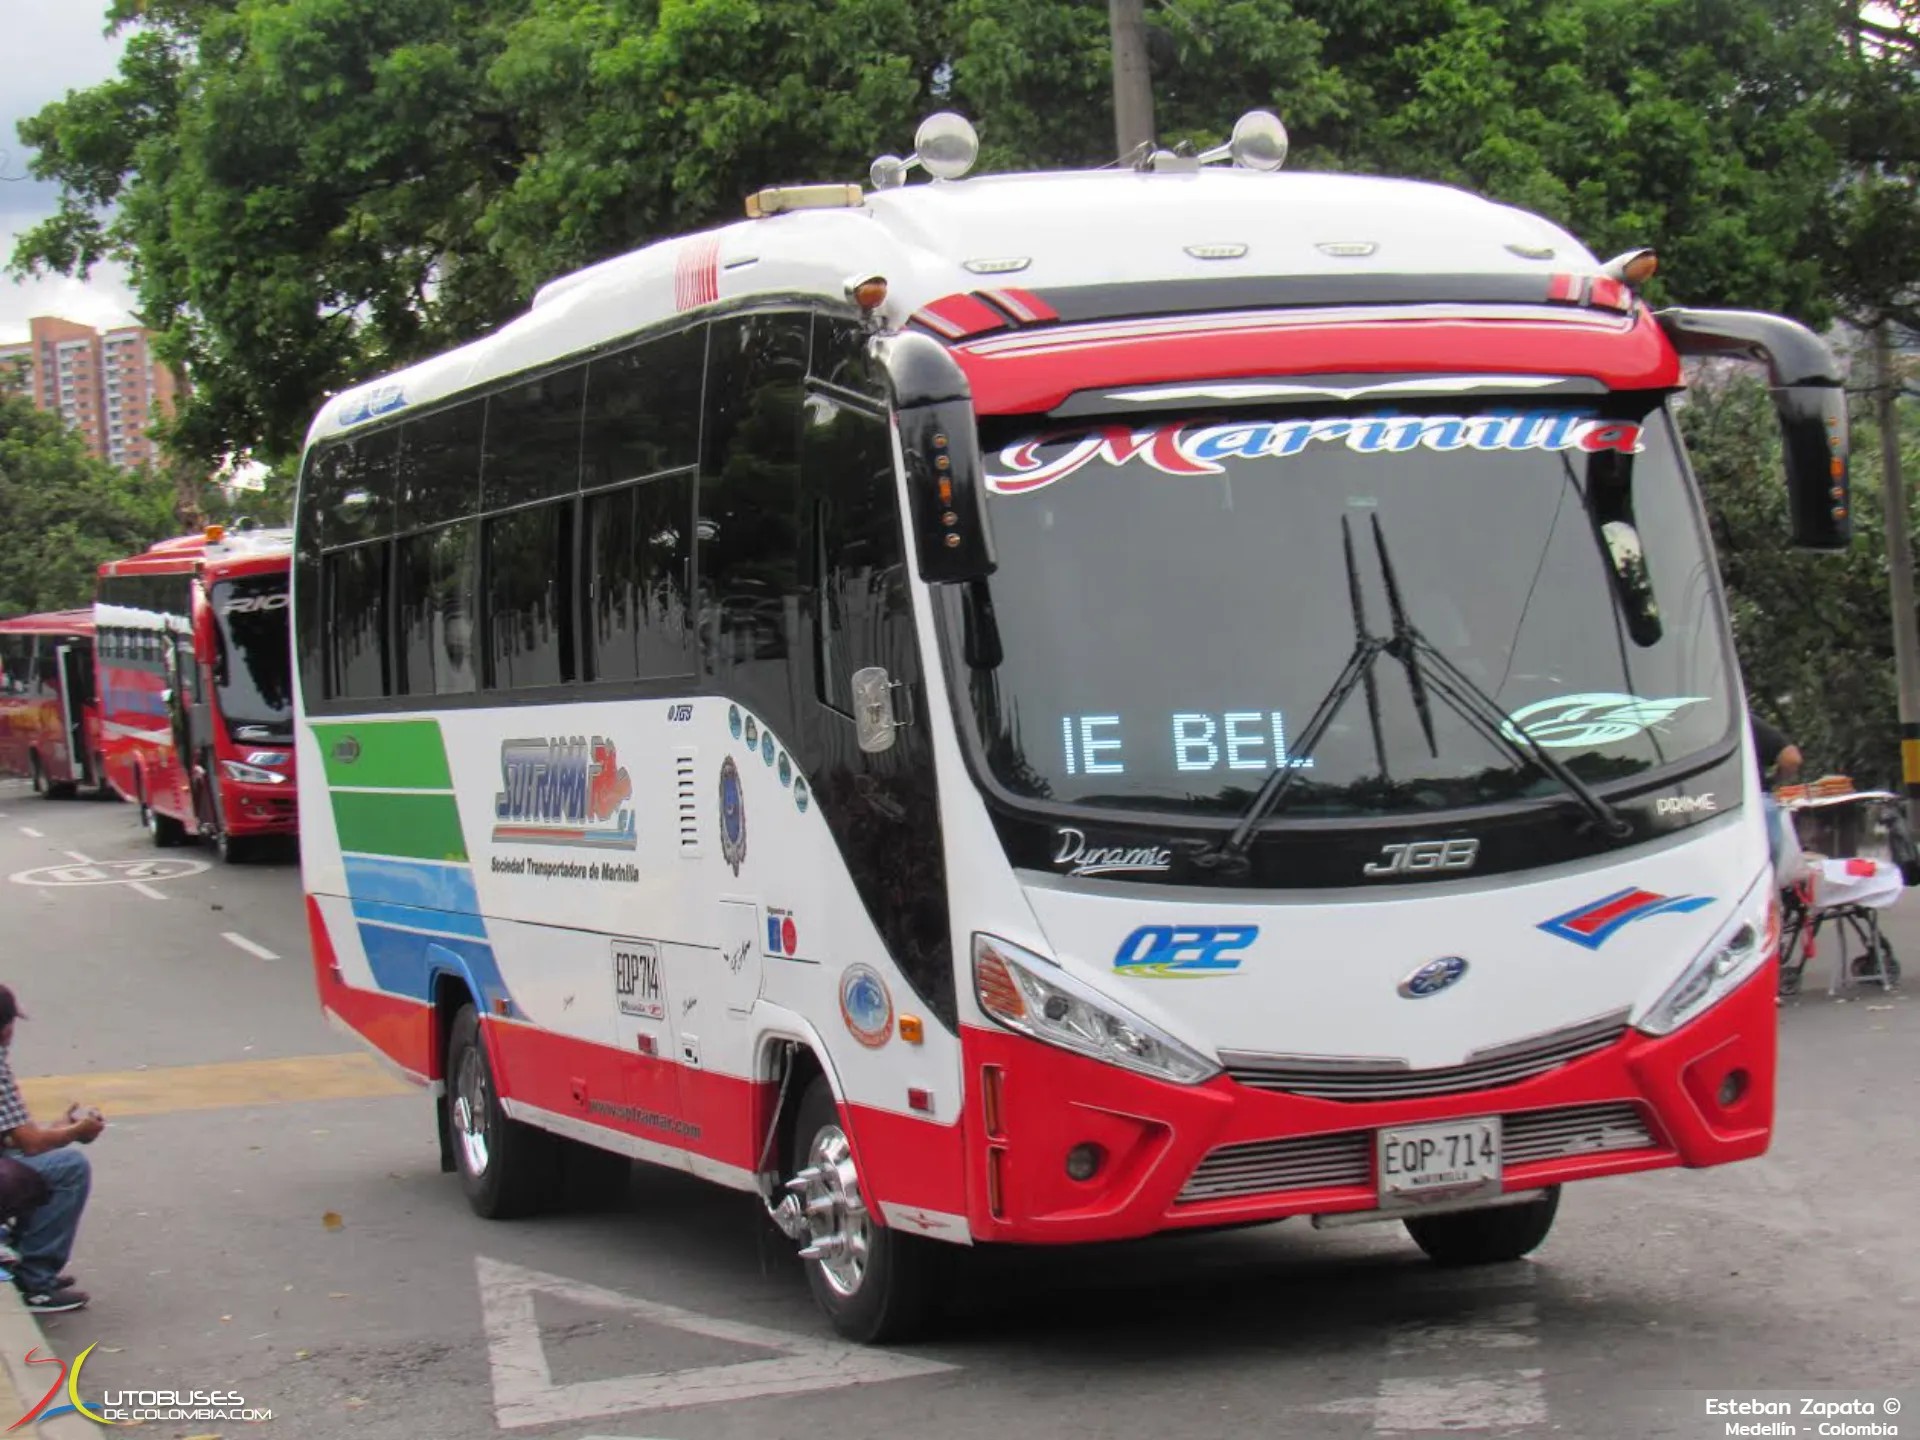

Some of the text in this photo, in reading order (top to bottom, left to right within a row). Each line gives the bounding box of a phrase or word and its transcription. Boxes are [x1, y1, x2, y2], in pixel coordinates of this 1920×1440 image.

[985, 408, 1645, 494] Marinilla
[1173, 712, 1314, 770] BEL
[1656, 792, 1717, 816] PRIME
[491, 856, 639, 882] Sociedad Transportadora de Marinilla
[1054, 828, 1171, 875] Dynamic
[1364, 838, 1480, 876] JGB
[1113, 925, 1259, 969] 022
